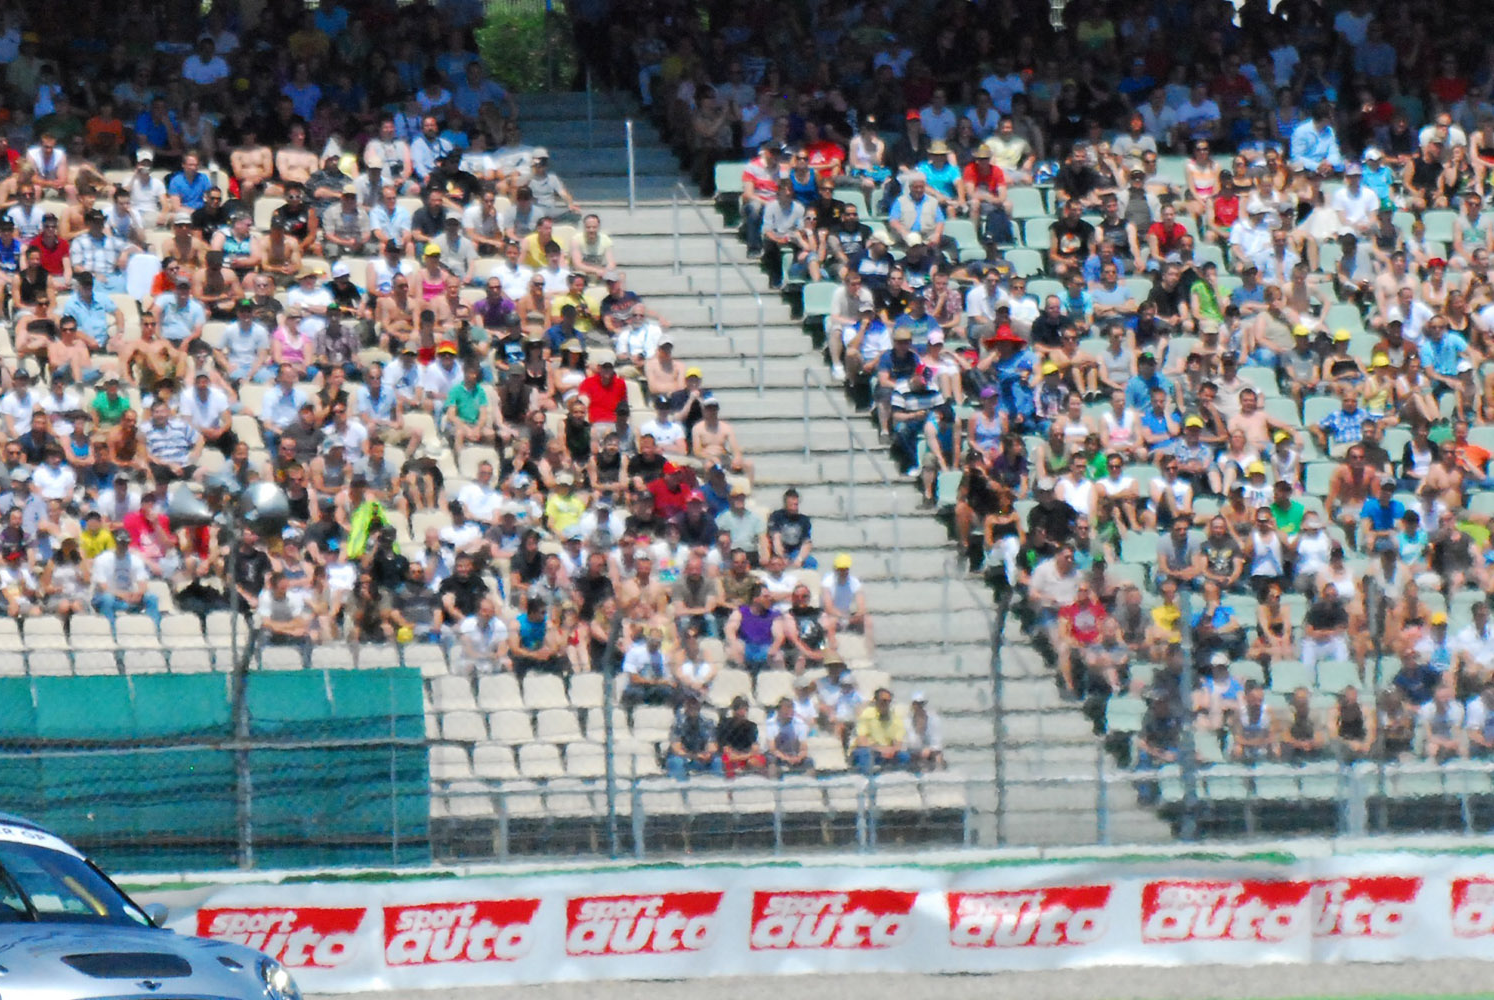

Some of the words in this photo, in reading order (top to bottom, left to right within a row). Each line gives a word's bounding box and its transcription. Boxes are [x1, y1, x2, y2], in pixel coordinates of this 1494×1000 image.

[209, 911, 298, 938] sport
[394, 904, 478, 932] sport
[576, 896, 663, 922] sport
[764, 893, 850, 918] sport
[950, 902, 1106, 946] auto
[1142, 897, 1309, 940] auto
[208, 926, 356, 967] uto
[385, 921, 534, 964] auto
[567, 910, 718, 953] auto
[751, 907, 914, 949] auto
